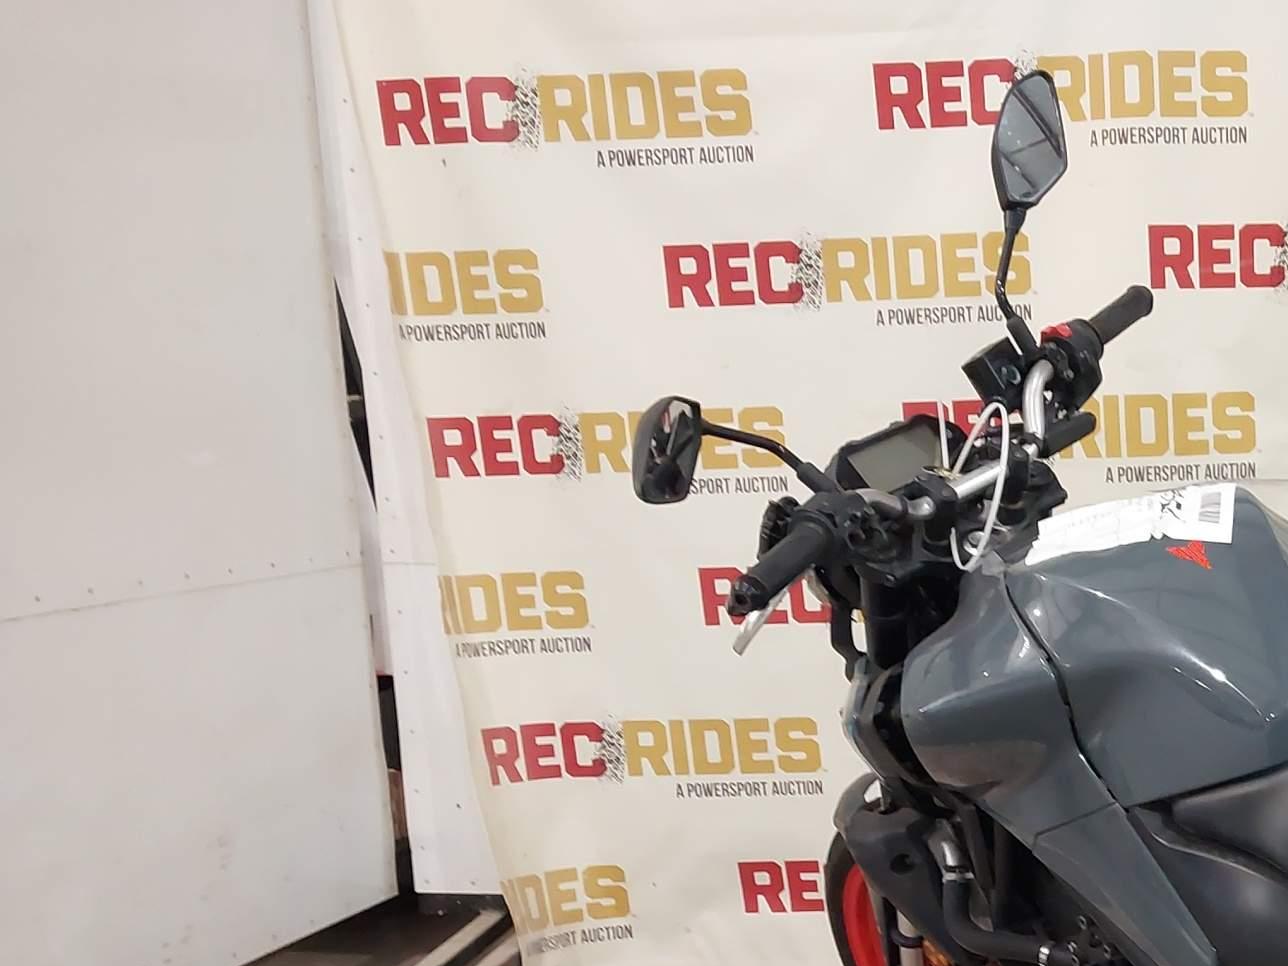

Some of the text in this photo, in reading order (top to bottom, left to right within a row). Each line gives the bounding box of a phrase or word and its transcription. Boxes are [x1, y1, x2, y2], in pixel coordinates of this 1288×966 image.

[872, 50, 1249, 131] REC RIDES
[377, 68, 753, 147] REC RIDES
[1090, 126, 1248, 148] A POWERSPORT AUCTION
[596, 145, 755, 169] A POWERSPORT AUCTION
[1147, 223, 1286, 289] REC
[663, 231, 1033, 309] REC RIDES
[383, 249, 544, 316] IDES
[876, 303, 1033, 327] A POWERSPORT AUCON
[407, 322, 491, 343] POWERSPORT
[495, 321, 547, 341] AUCTION
[426, 406, 785, 479] REC RES
[734, 475, 788, 494] AUCTION
[1105, 462, 1256, 484] A POWERSPORT AUCTION
[540, 636, 592, 655] AUCTION
[481, 716, 822, 786] REC RIDES
[676, 779, 824, 799] A POWERSPORT AUCTION
[737, 860, 825, 913] RE
[581, 924, 634, 944] AUCTION
